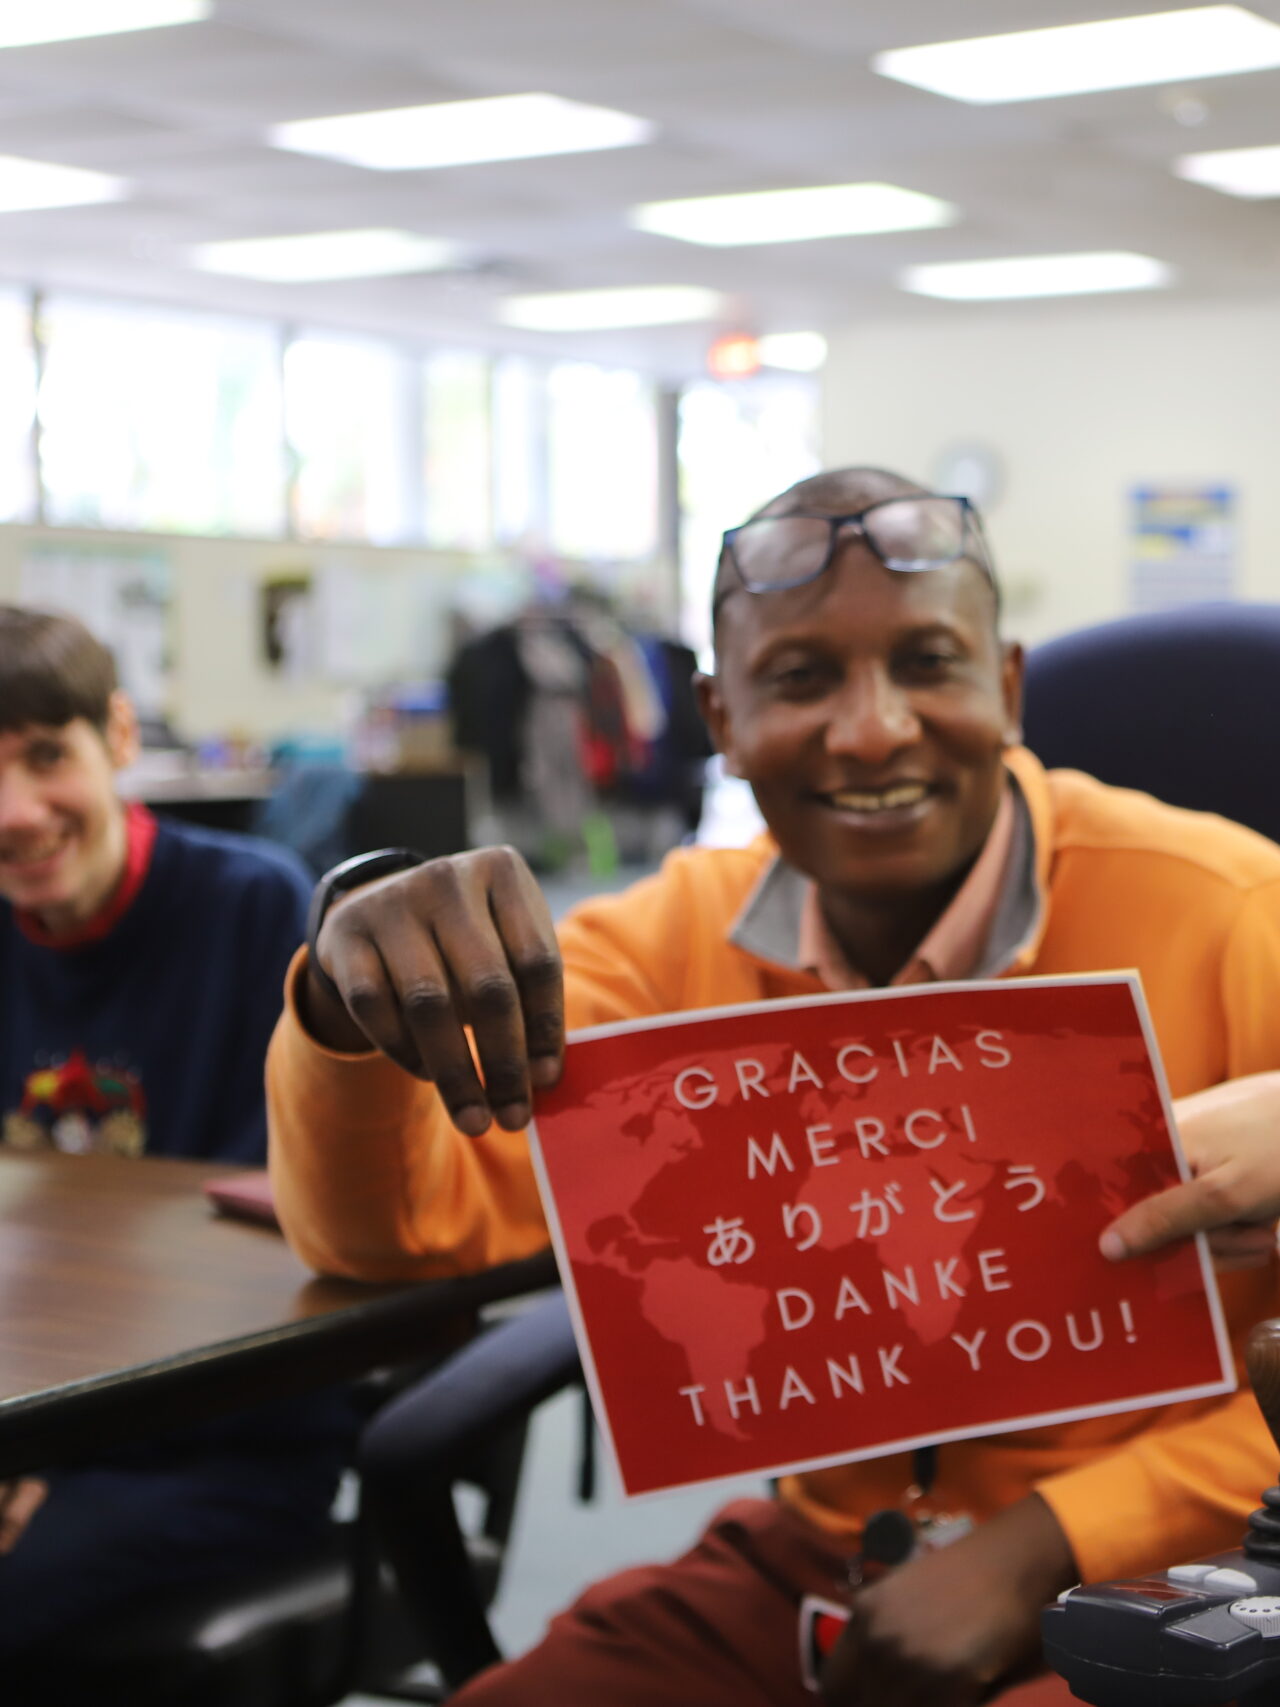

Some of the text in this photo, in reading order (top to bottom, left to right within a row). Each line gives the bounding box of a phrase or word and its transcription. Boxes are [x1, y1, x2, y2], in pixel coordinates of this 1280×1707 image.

[673, 1030, 1012, 1110] GRACIAS
[746, 1104, 977, 1179] MERCI
[703, 1165, 1047, 1266] ありがとう
[776, 1249, 1012, 1331] DANKE
[679, 1301, 1137, 1426] THANK YOU!
